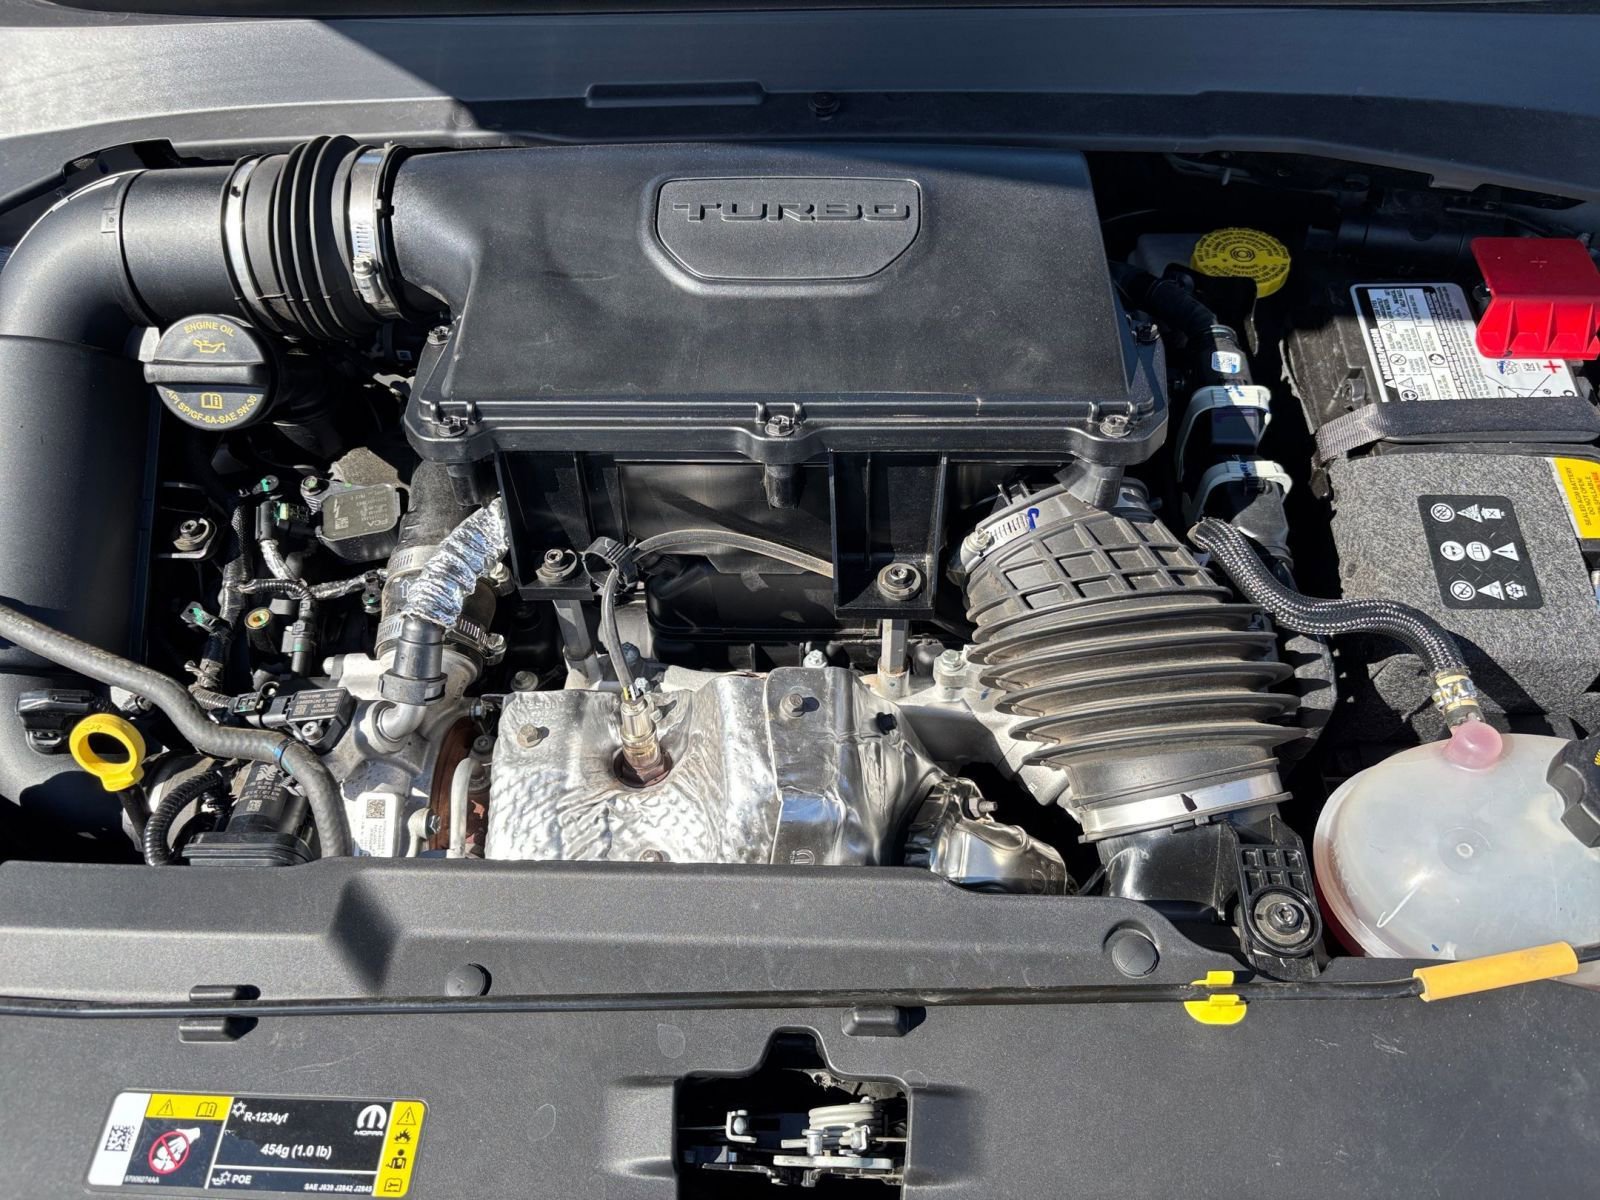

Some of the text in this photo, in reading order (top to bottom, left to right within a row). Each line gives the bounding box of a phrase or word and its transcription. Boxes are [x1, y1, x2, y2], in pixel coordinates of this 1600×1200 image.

[673, 199, 910, 223] TURBO
[184, 321, 235, 337] ENGINE OIL
[165, 389, 179, 405] API
[237, 394, 257, 417] 5W-30
[243, 1111, 289, 1125] R-1234yf
[260, 1143, 332, 1160] 454g (1.0 lb)
[231, 1174, 252, 1185] POE
[304, 1183, 319, 1191] SAE
